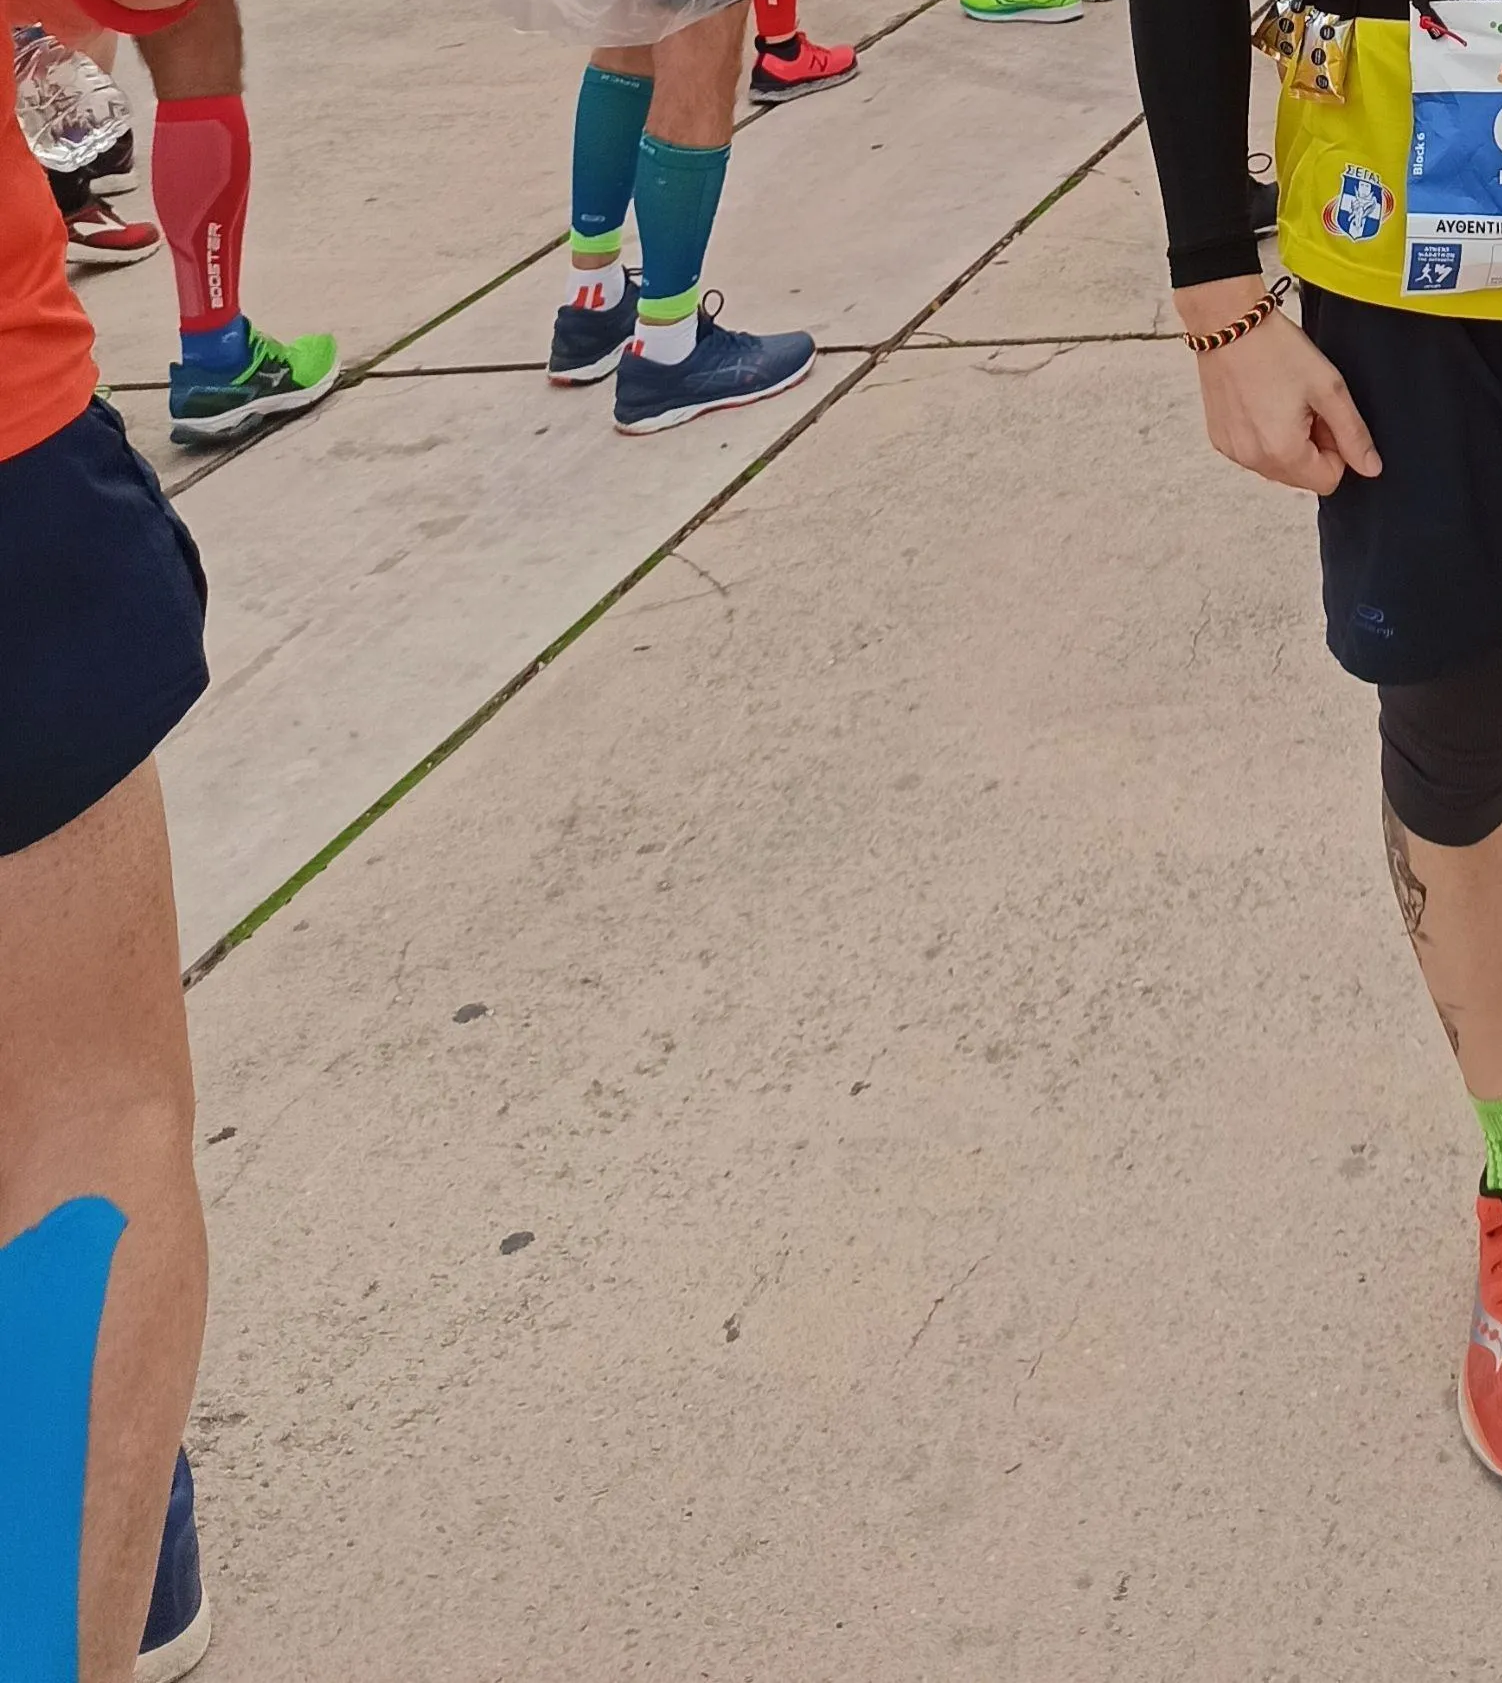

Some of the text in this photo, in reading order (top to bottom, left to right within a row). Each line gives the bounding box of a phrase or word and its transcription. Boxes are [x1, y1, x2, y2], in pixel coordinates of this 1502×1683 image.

[1413, 132, 1425, 176] Block 6
[206, 221, 224, 310] BOOSTER
